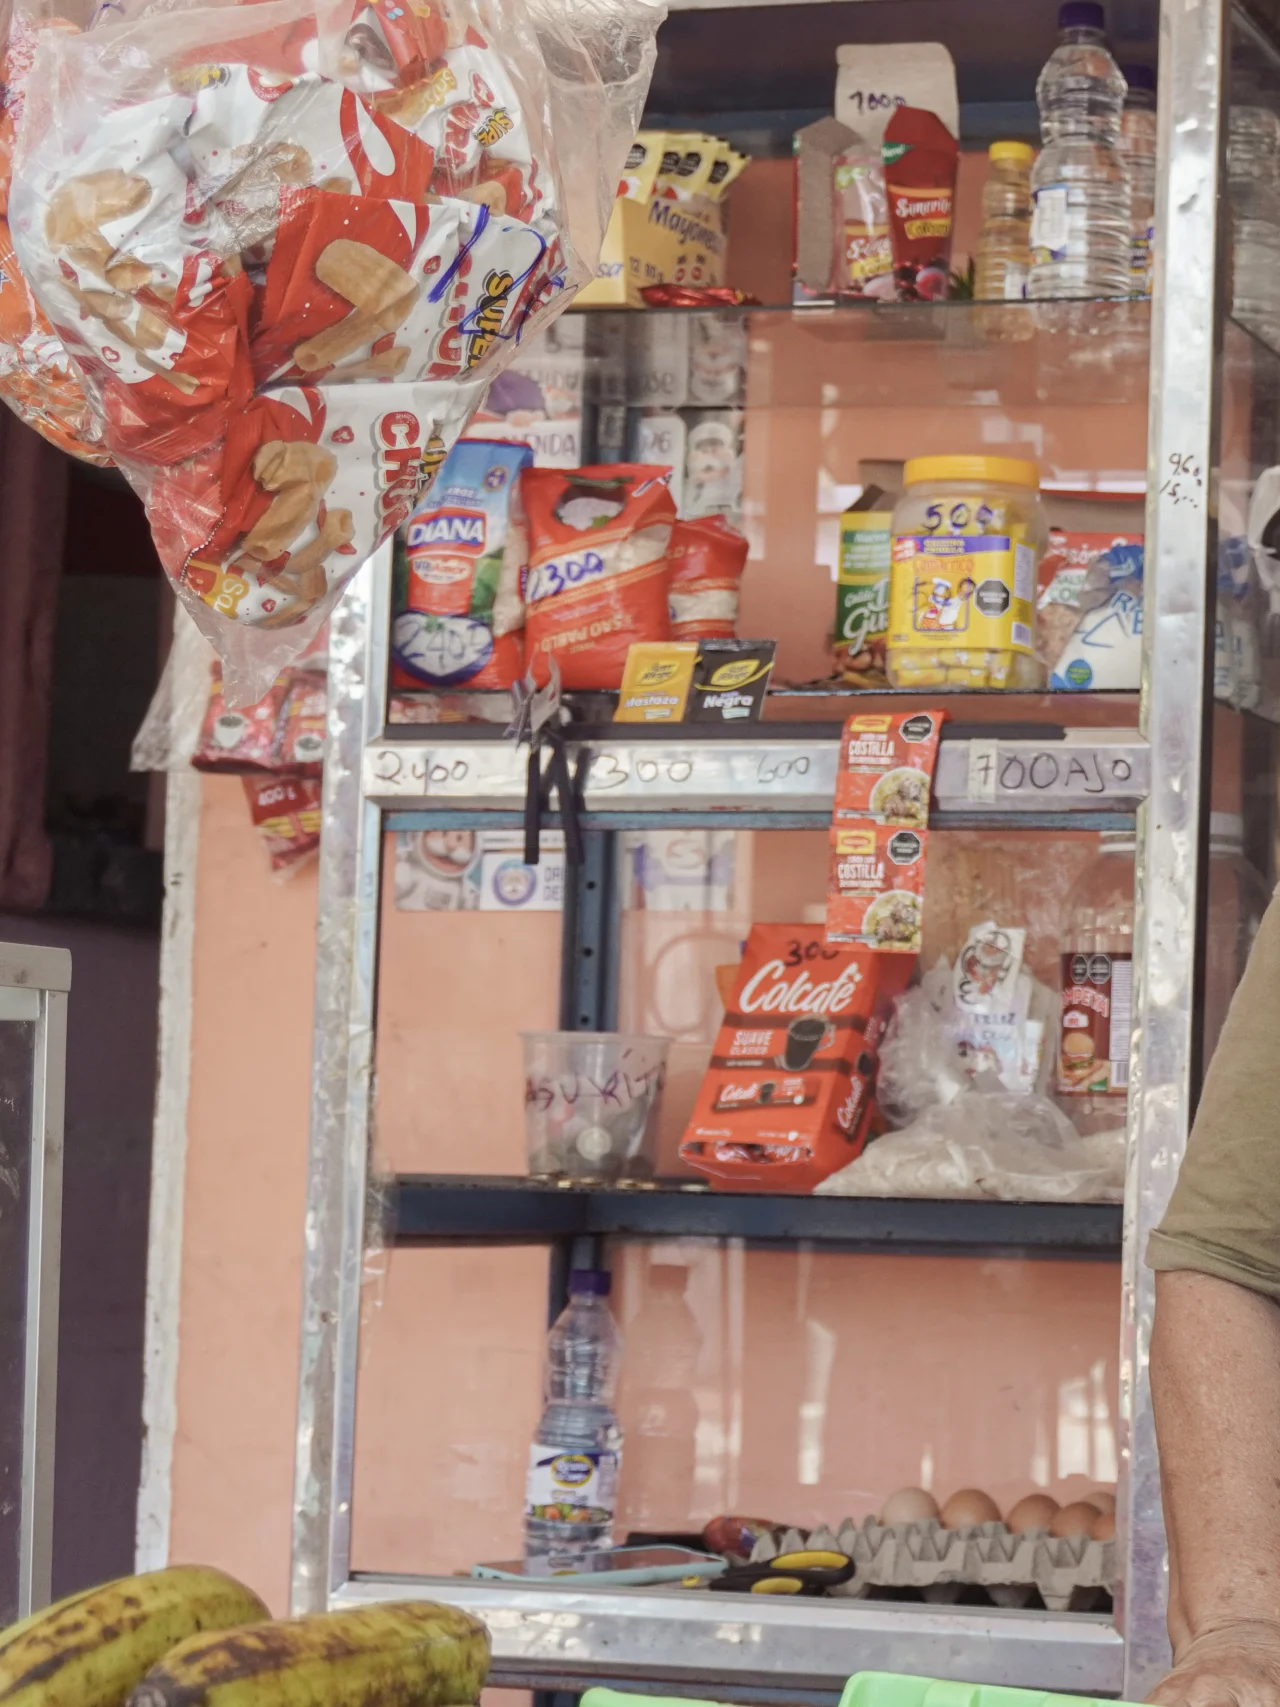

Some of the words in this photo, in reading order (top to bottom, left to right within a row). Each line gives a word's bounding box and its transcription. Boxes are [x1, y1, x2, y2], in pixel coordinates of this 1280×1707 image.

[408, 517, 484, 546] DIANA
[702, 695, 755, 710] Negra
[849, 740, 894, 757] COSTILLA
[837, 863, 885, 880] COSTILLA
